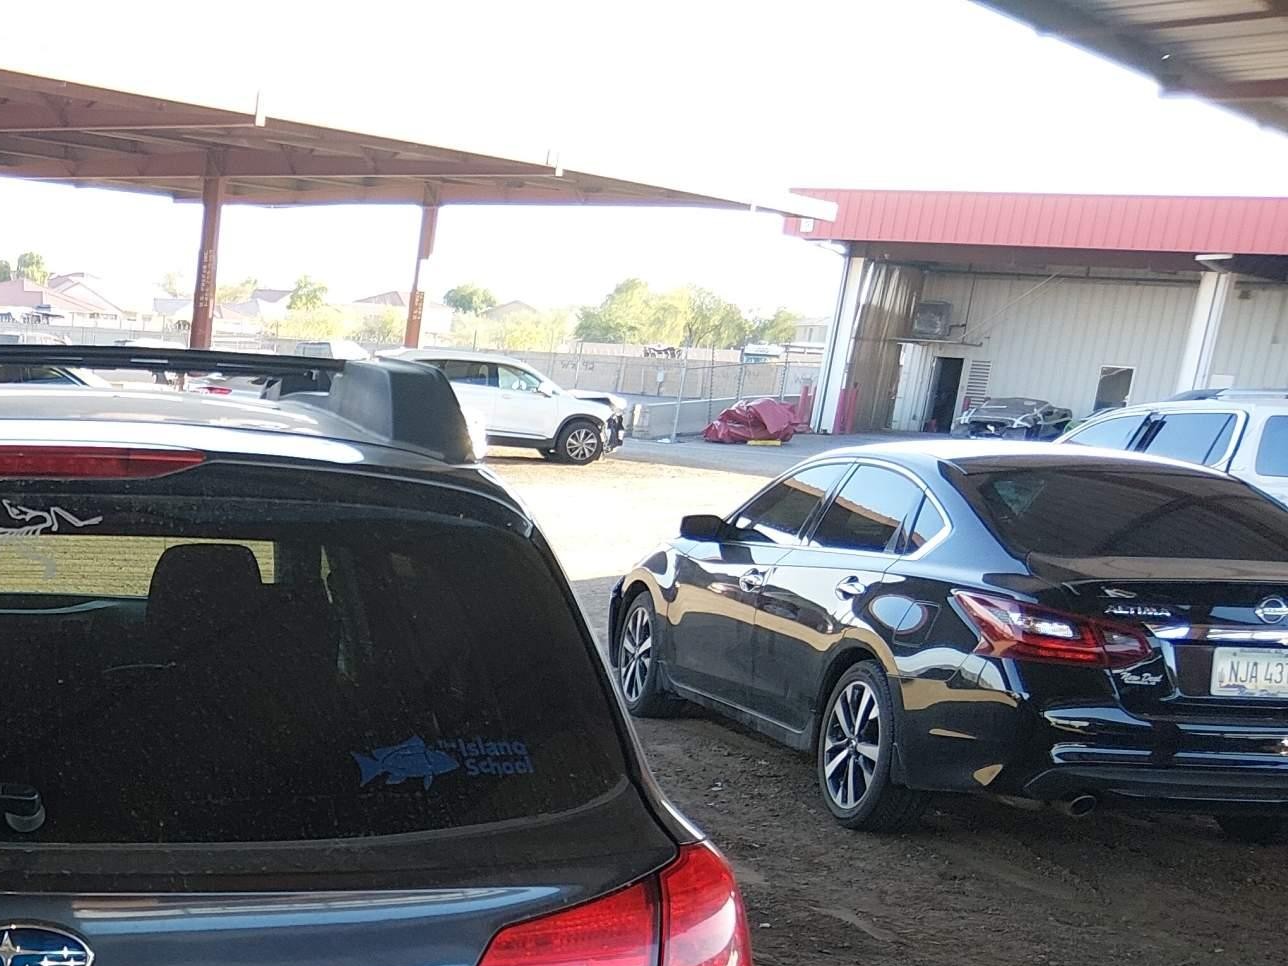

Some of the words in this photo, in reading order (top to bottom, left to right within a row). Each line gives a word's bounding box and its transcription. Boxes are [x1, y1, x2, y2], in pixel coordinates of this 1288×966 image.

[1103, 605, 1172, 617] ALTIMA
[1228, 660, 1259, 683] NJA
[1263, 661, 1288, 684] 43
[456, 736, 528, 757] Island
[465, 756, 535, 776] School
